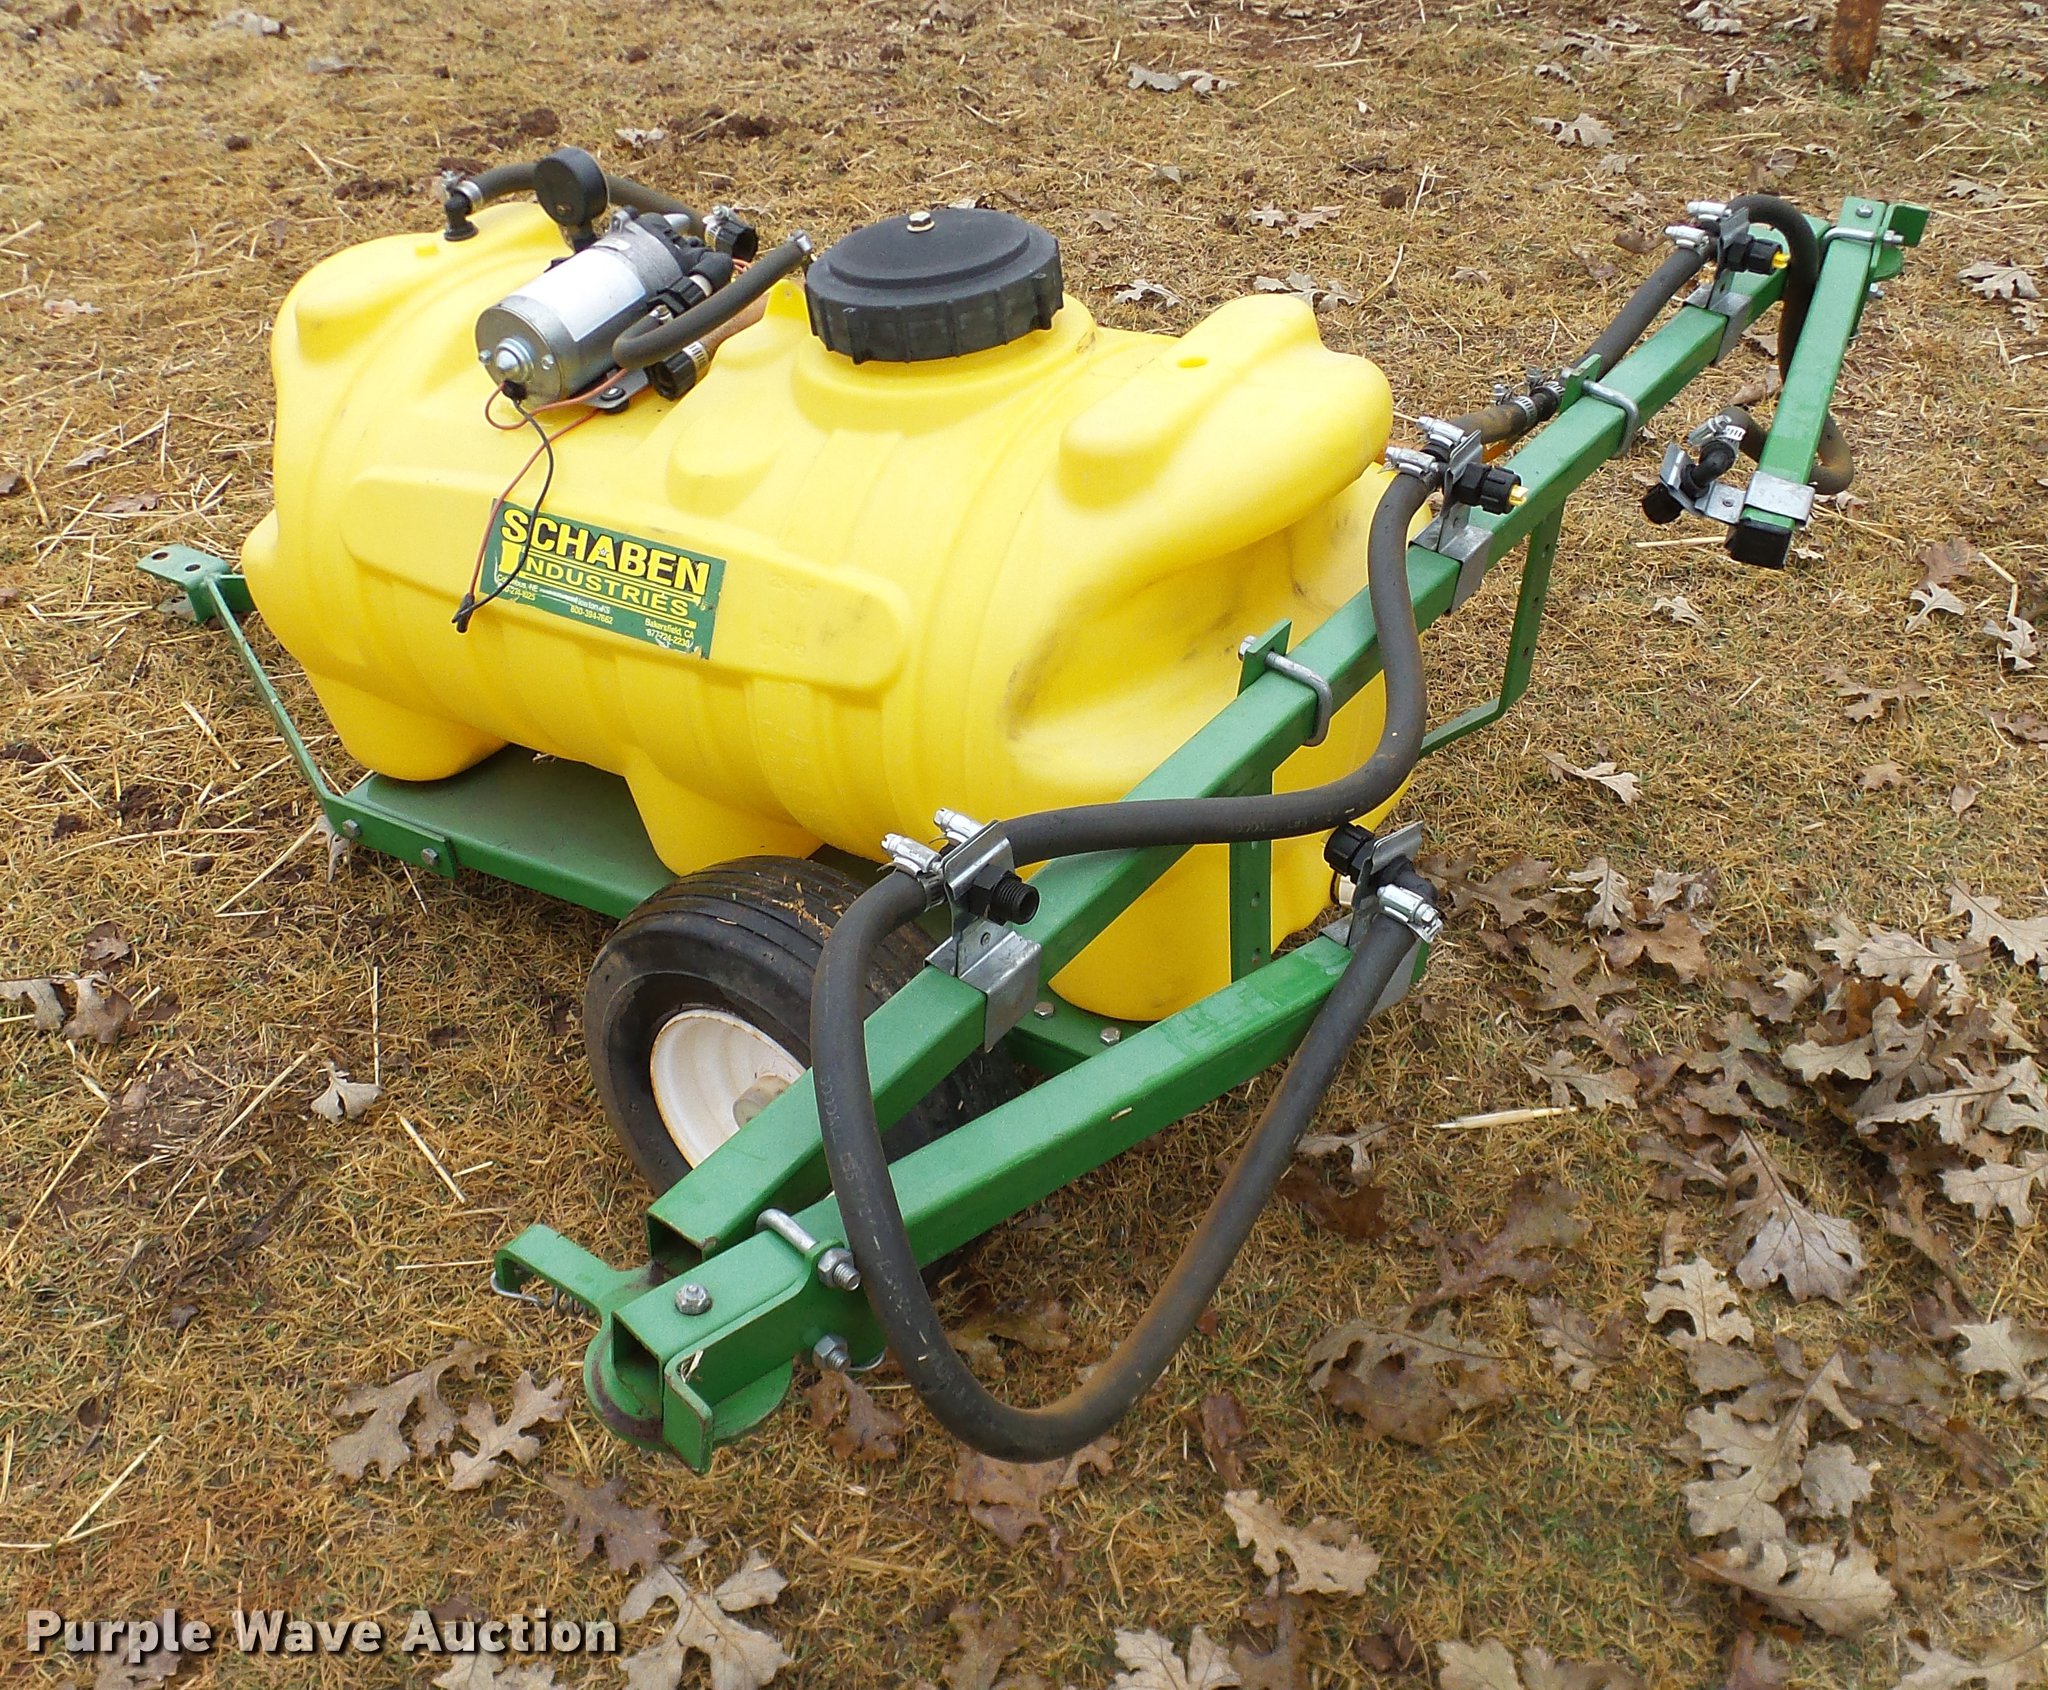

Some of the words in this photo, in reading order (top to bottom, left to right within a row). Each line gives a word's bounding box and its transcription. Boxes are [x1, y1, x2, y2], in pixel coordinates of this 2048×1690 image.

[501, 508, 711, 595] SCHABEN
[644, 618, 682, 637] Bakersfield,
[684, 629, 694, 640] CA
